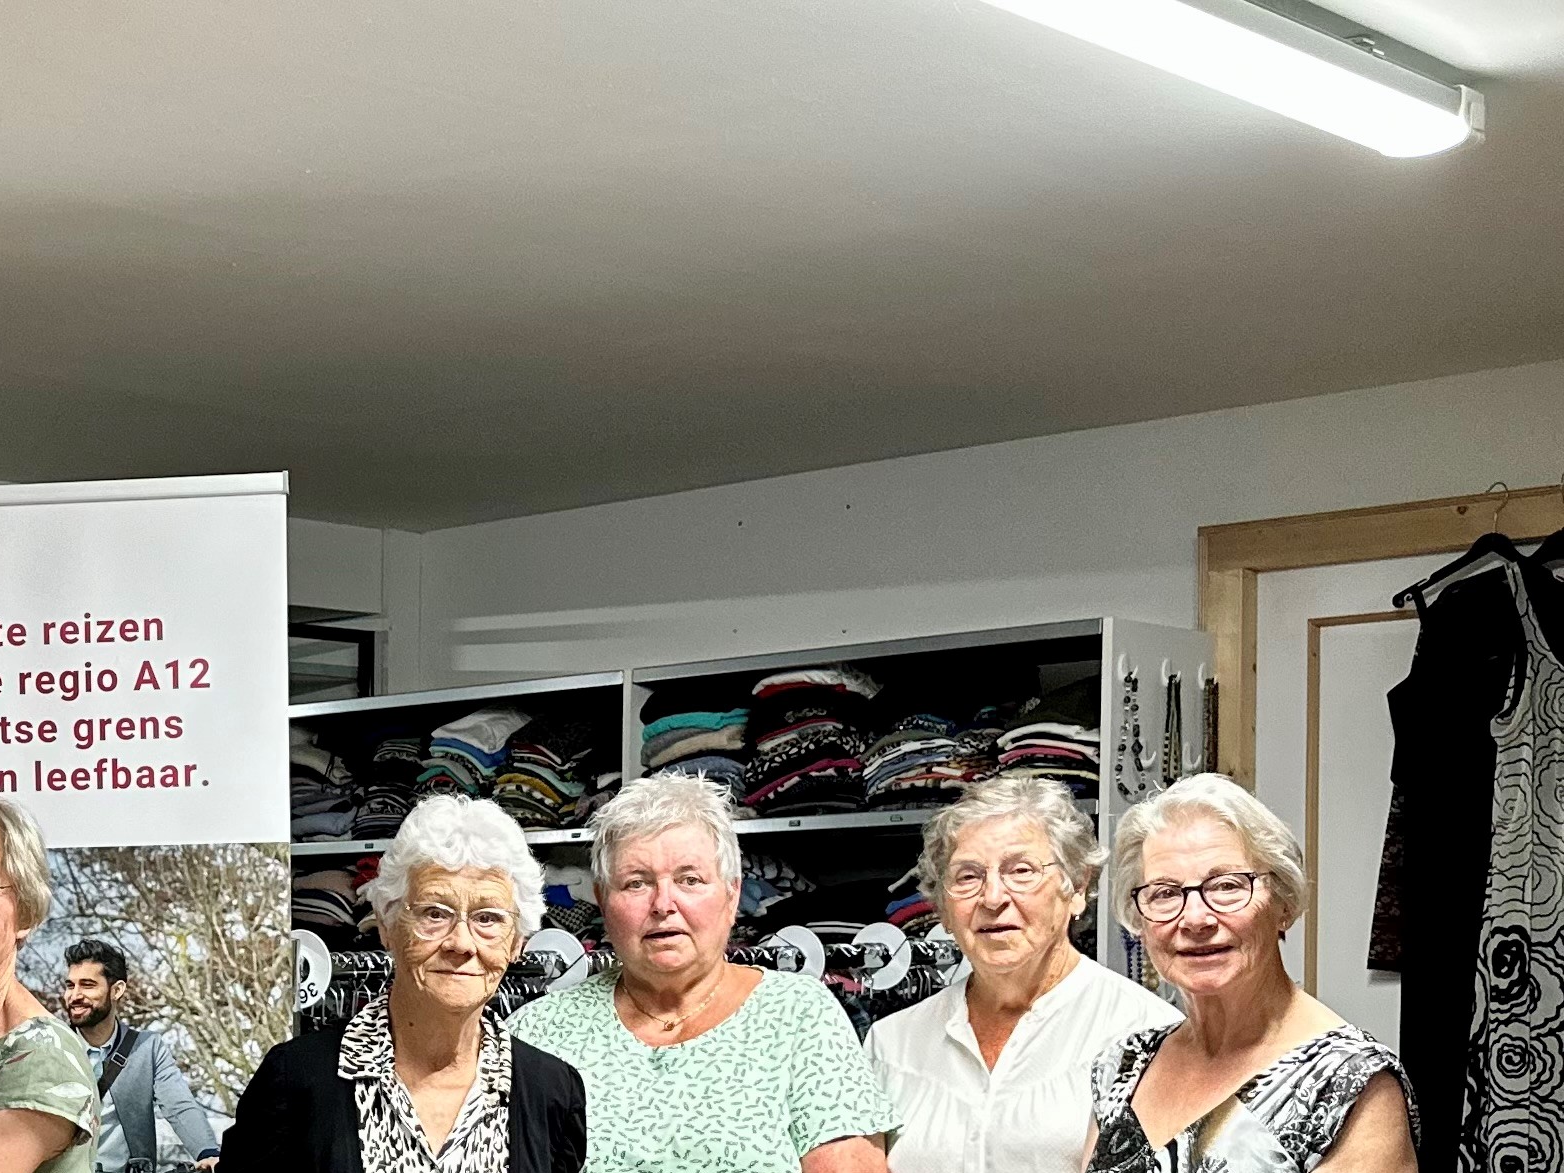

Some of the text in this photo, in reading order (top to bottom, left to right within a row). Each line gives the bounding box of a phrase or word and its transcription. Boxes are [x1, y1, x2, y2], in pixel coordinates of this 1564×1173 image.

[43, 612, 164, 645] reizen
[18, 661, 118, 702] regio
[133, 658, 211, 692] A12
[73, 715, 184, 751] grens
[35, 757, 210, 793] leefbaar.
